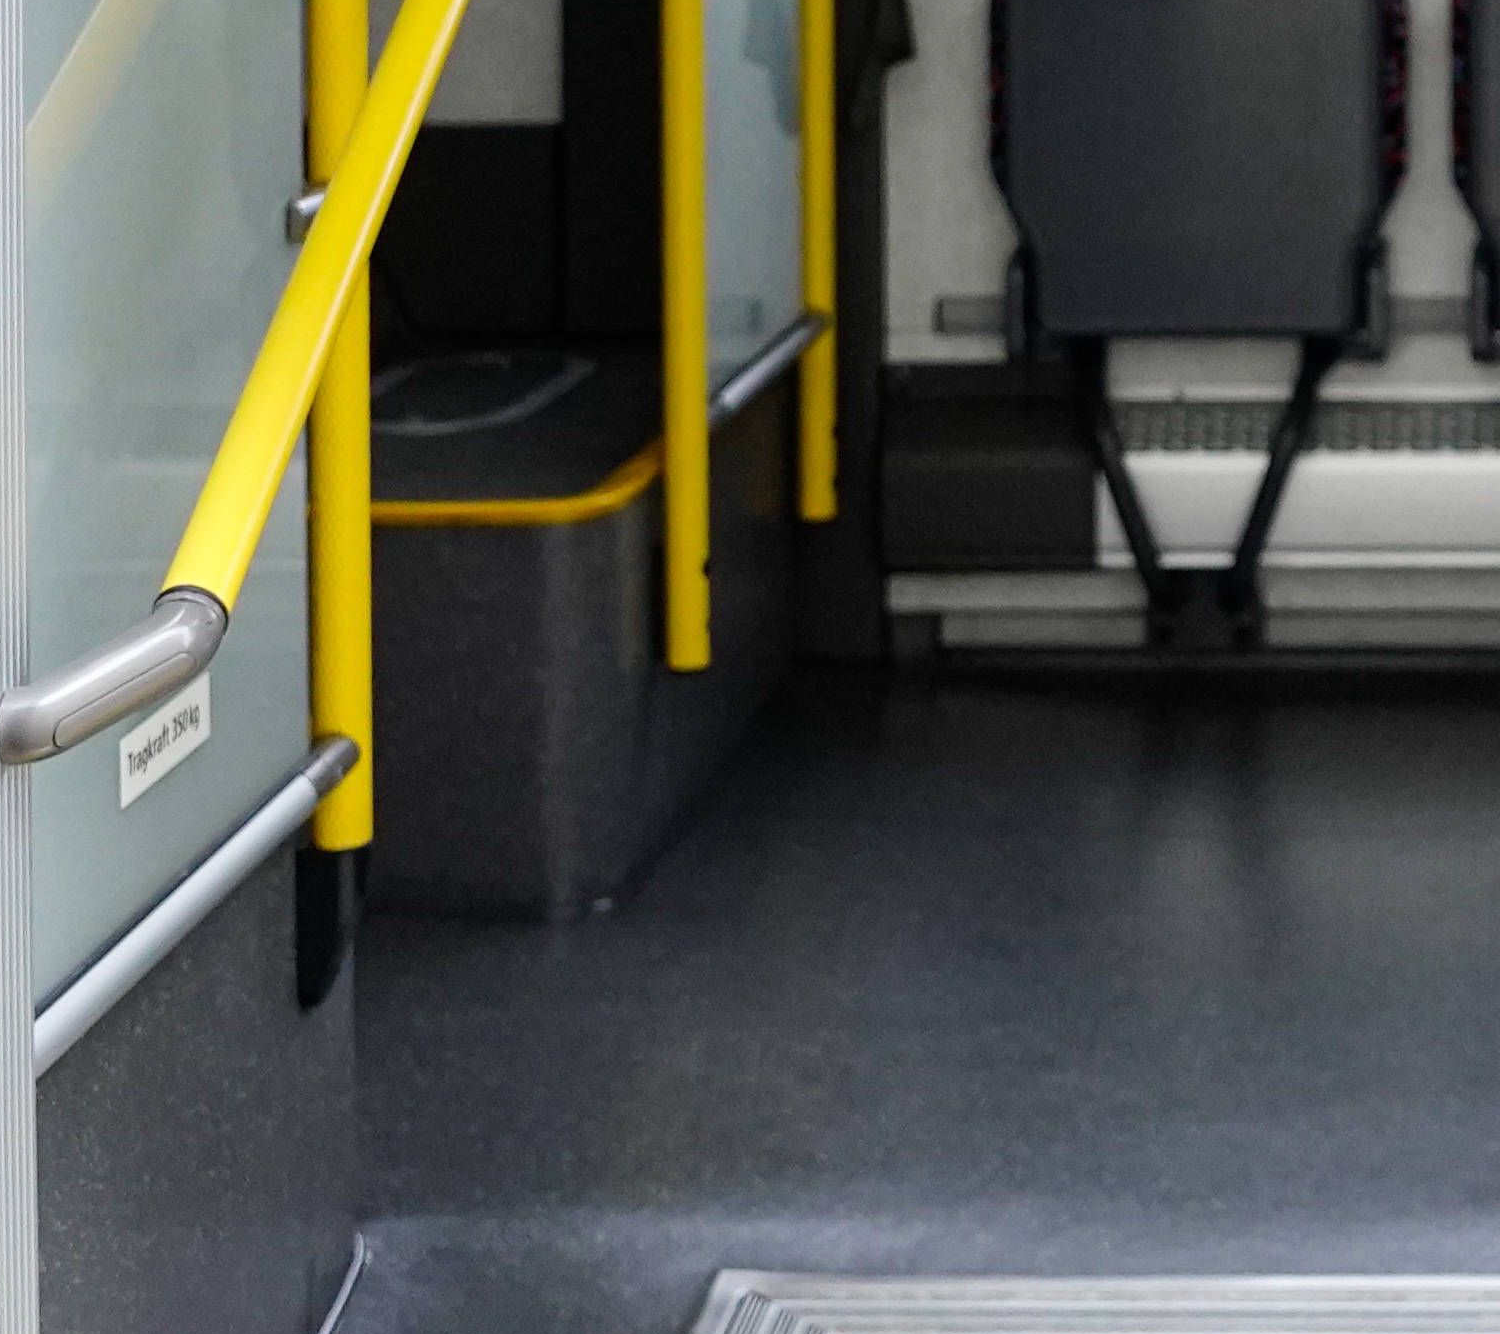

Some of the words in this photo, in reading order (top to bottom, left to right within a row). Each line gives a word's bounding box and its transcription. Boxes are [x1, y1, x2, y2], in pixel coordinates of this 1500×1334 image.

[128, 723, 170, 776] Tragkraft
[172, 710, 188, 742] 350
[189, 704, 200, 731] kg
